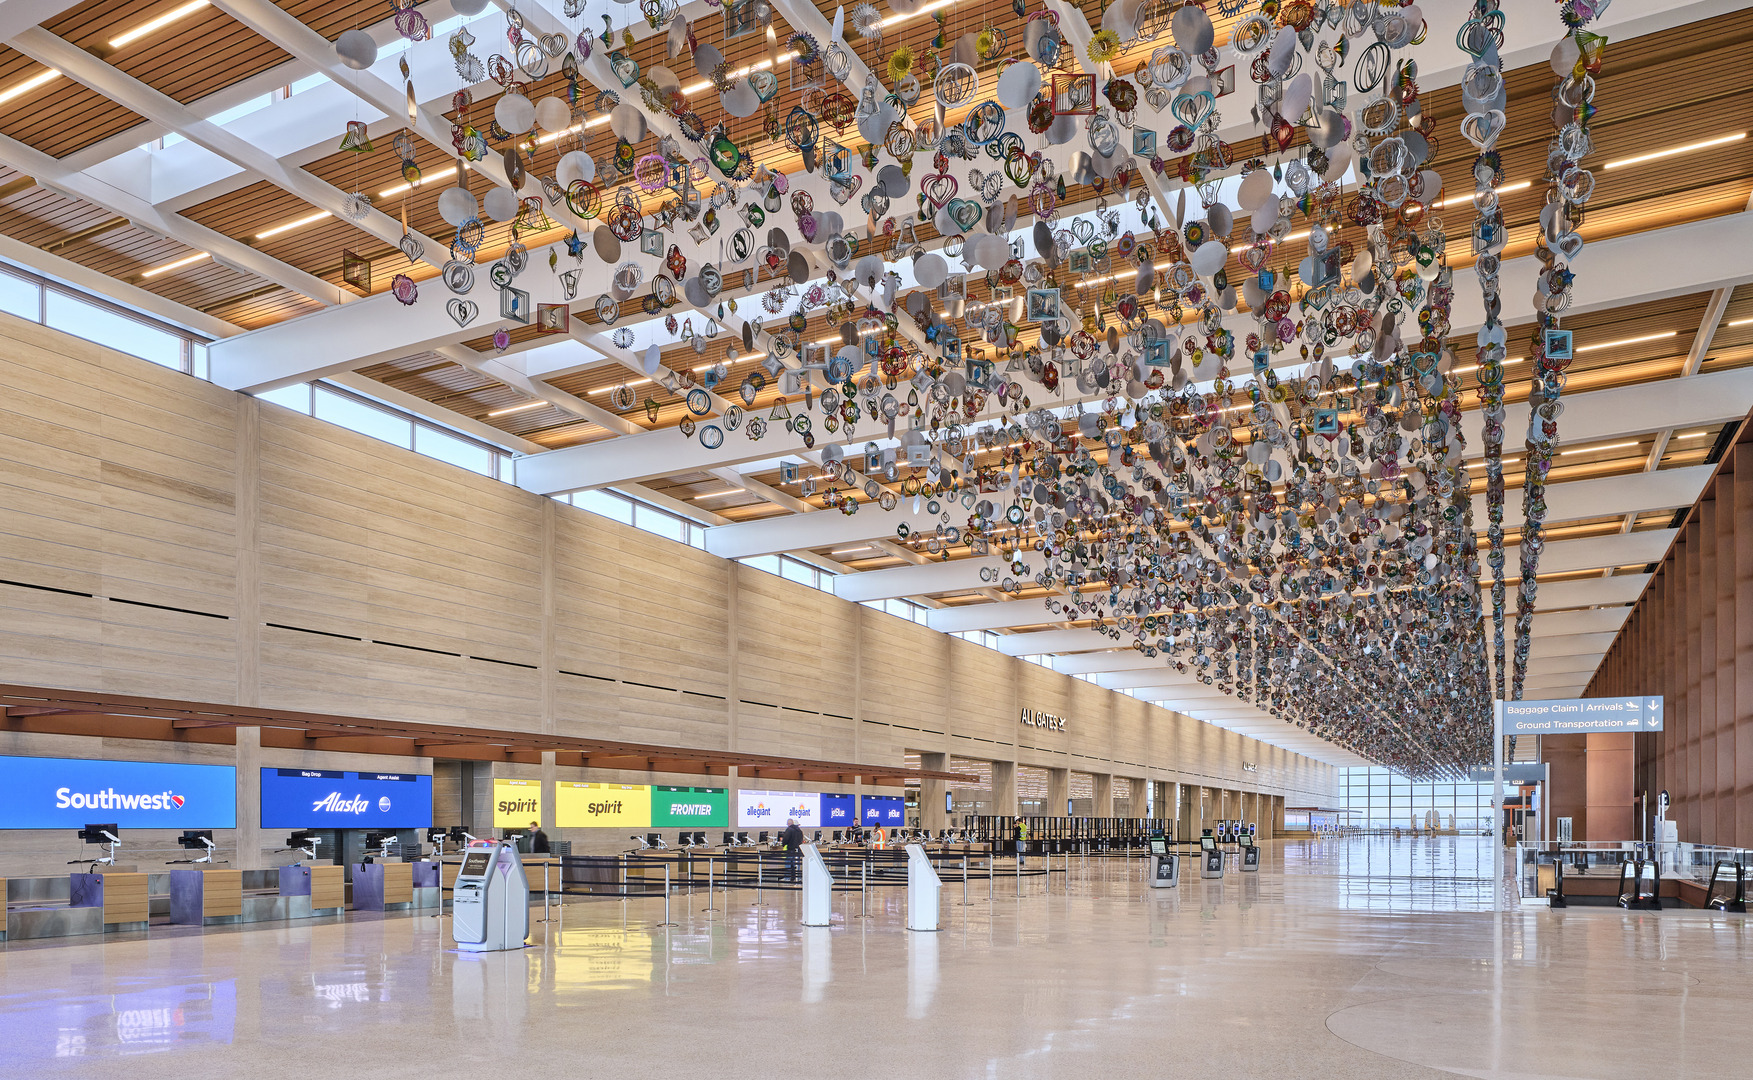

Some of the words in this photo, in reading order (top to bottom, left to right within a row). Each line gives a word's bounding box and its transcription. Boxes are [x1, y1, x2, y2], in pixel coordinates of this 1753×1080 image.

[1507, 706, 1549, 715] Baggage
[1551, 704, 1578, 713] Claim
[1586, 702, 1624, 712] Arrivals
[1021, 708, 1035, 725] ALL
[1036, 711, 1057, 730] GATES
[1516, 720, 1551, 730] Ground
[1553, 719, 1624, 729] Transportation
[56, 787, 171, 810] Southwest
[312, 791, 370, 815] Alaska
[498, 798, 538, 815] spirit
[587, 800, 623, 816] spirit
[670, 803, 712, 816] FRONTIER
[747, 806, 771, 818] allegiant
[789, 806, 811, 818] allegiant
